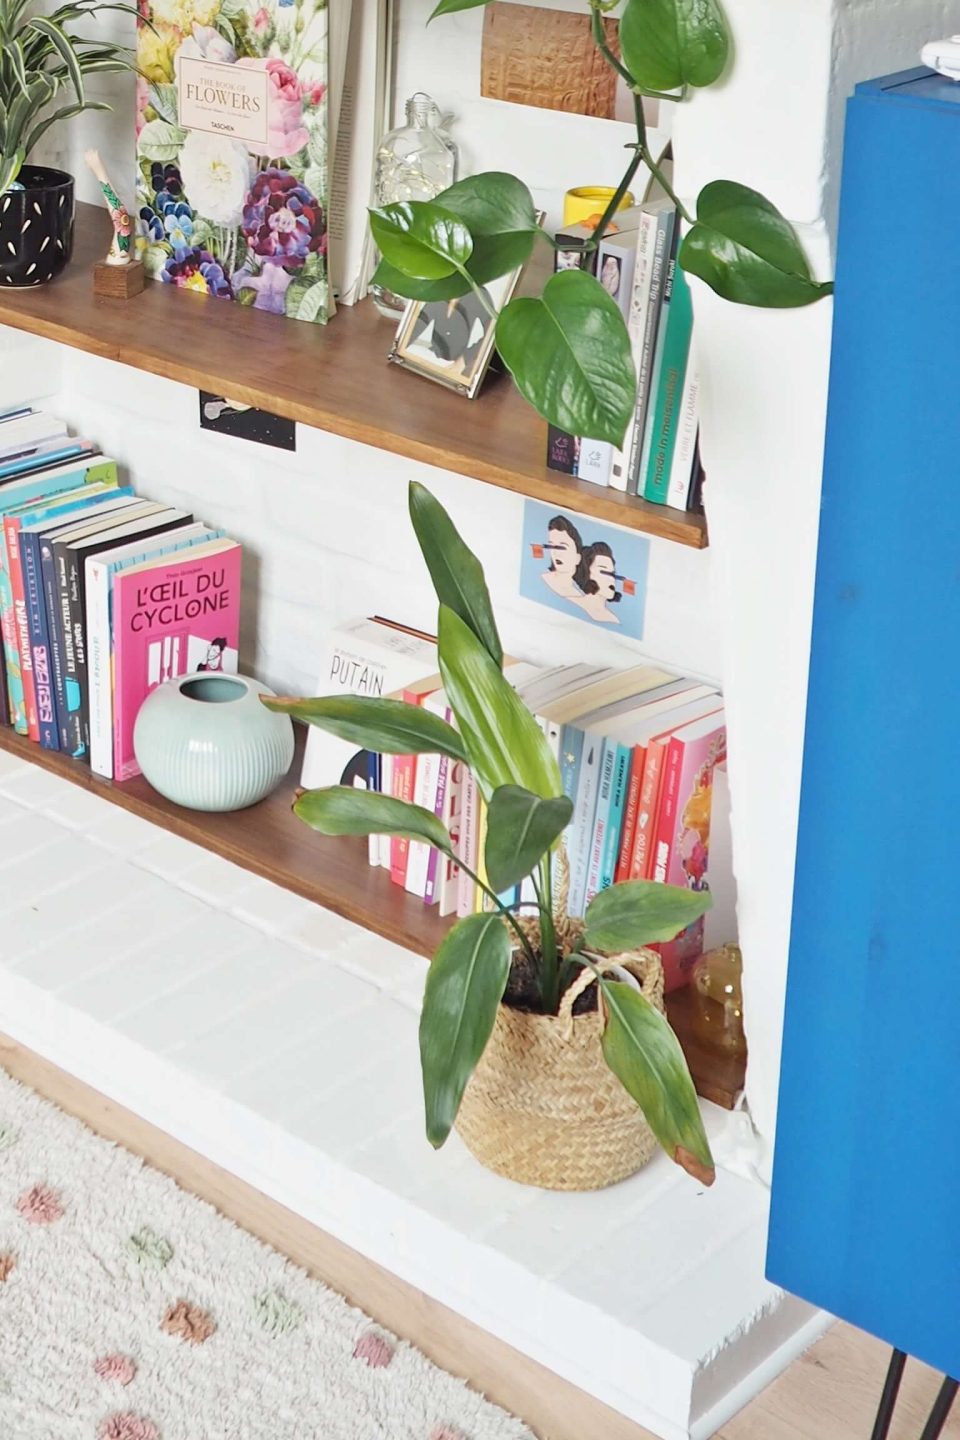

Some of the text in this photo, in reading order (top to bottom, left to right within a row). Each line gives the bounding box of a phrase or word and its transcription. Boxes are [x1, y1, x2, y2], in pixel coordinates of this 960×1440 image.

[186, 84, 261, 113] FLOWERS
[211, 121, 235, 132] TASCHEN
[657, 229, 666, 255] Glass
[650, 282, 659, 301] Trip
[688, 385, 699, 421] FLAMME
[659, 437, 667, 448] in
[654, 451, 665, 486] made
[137, 568, 225, 608] L'ŒIL DU
[61, 596, 72, 632] ACTEUR
[130, 590, 230, 632] CYCLONE
[64, 630, 74, 660] JEUNE
[67, 658, 76, 672] LE
[329, 655, 384, 696] PUTAIN
